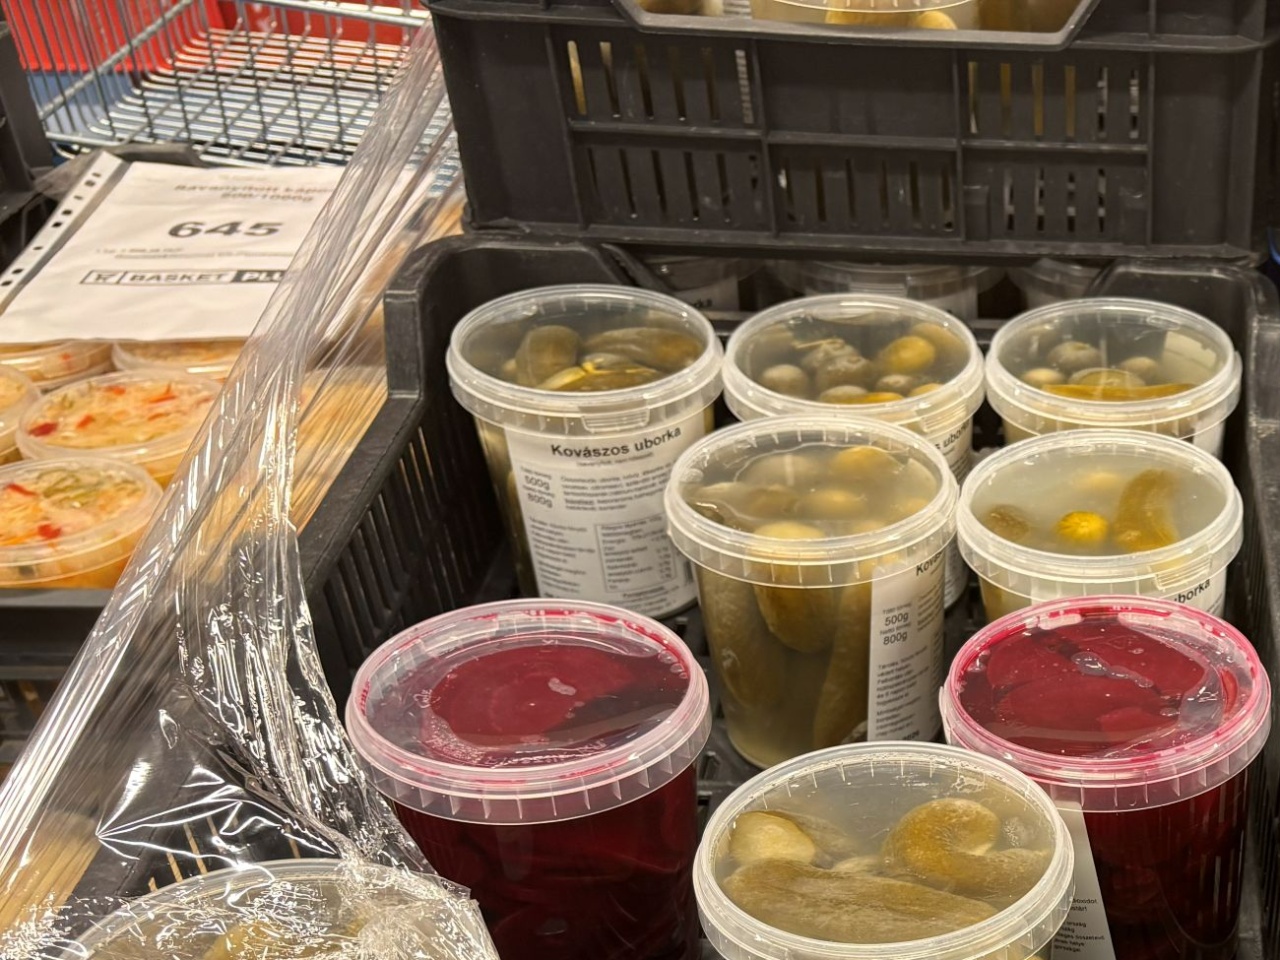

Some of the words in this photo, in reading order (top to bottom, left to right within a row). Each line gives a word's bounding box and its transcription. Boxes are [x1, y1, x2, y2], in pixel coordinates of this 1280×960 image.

[168, 220, 283, 239] 645
[129, 273, 227, 283] BASKET
[550, 444, 629, 459] Kovászos
[634, 426, 682, 452] uborka
[1173, 579, 1211, 604] borka
[884, 611, 909, 627] 500g
[883, 630, 908, 646] 800g
